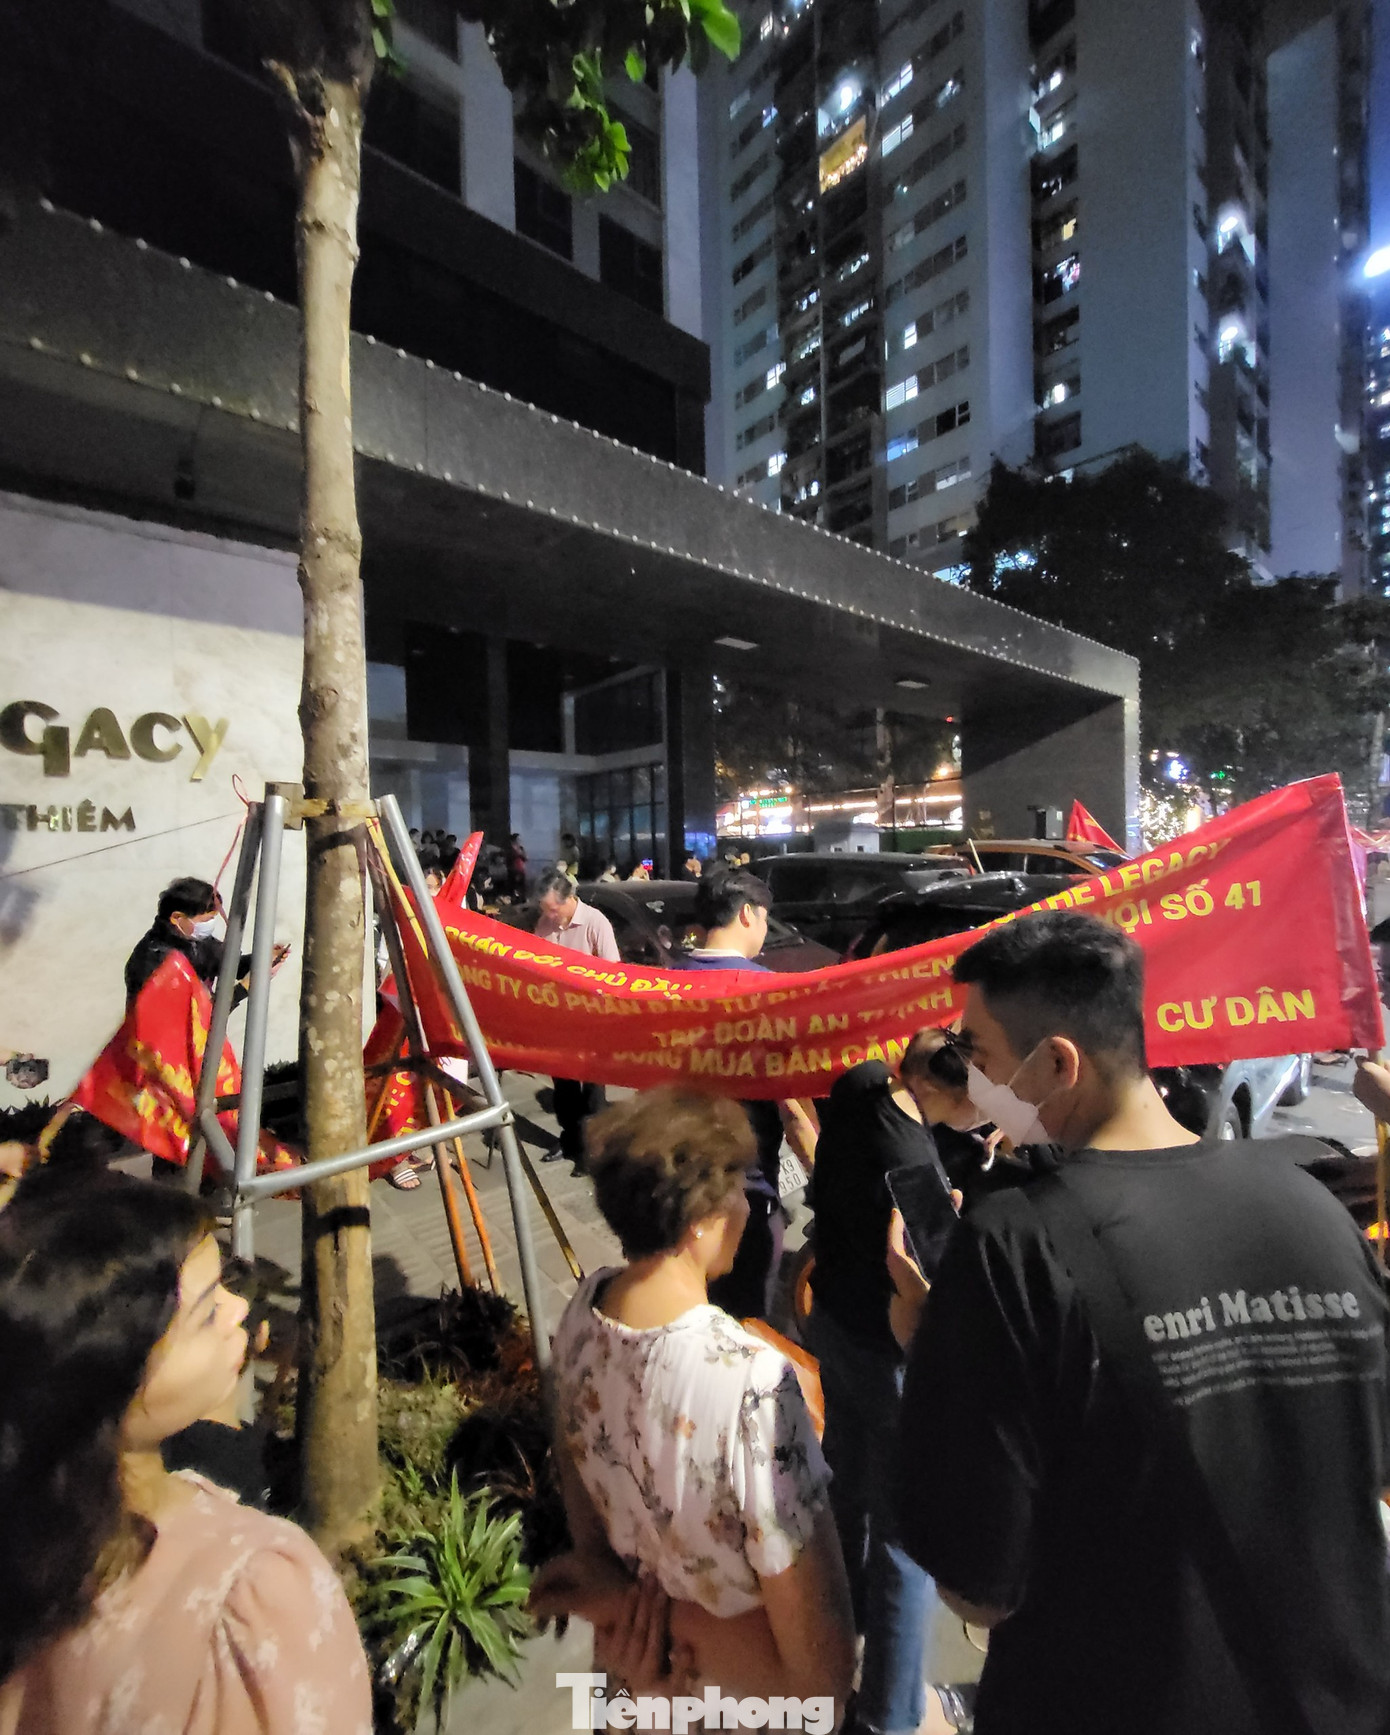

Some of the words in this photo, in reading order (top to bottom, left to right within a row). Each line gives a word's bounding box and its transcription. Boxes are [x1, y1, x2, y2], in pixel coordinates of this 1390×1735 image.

[0, 700, 230, 783] GACY
[1098, 838, 1232, 897] LEGACY
[496, 973, 523, 999] TY
[1159, 878, 1214, 921] SỐ
[1225, 880, 1262, 910] 41
[690, 1046, 756, 1077] MUA
[765, 1044, 832, 1078] BÁN
[1157, 995, 1217, 1033] CƯ
[1227, 986, 1316, 1029] DÂN
[808, 1013, 850, 1035] AN
[1143, 1297, 1216, 1342] enri
[1219, 1286, 1360, 1327] Matisse
